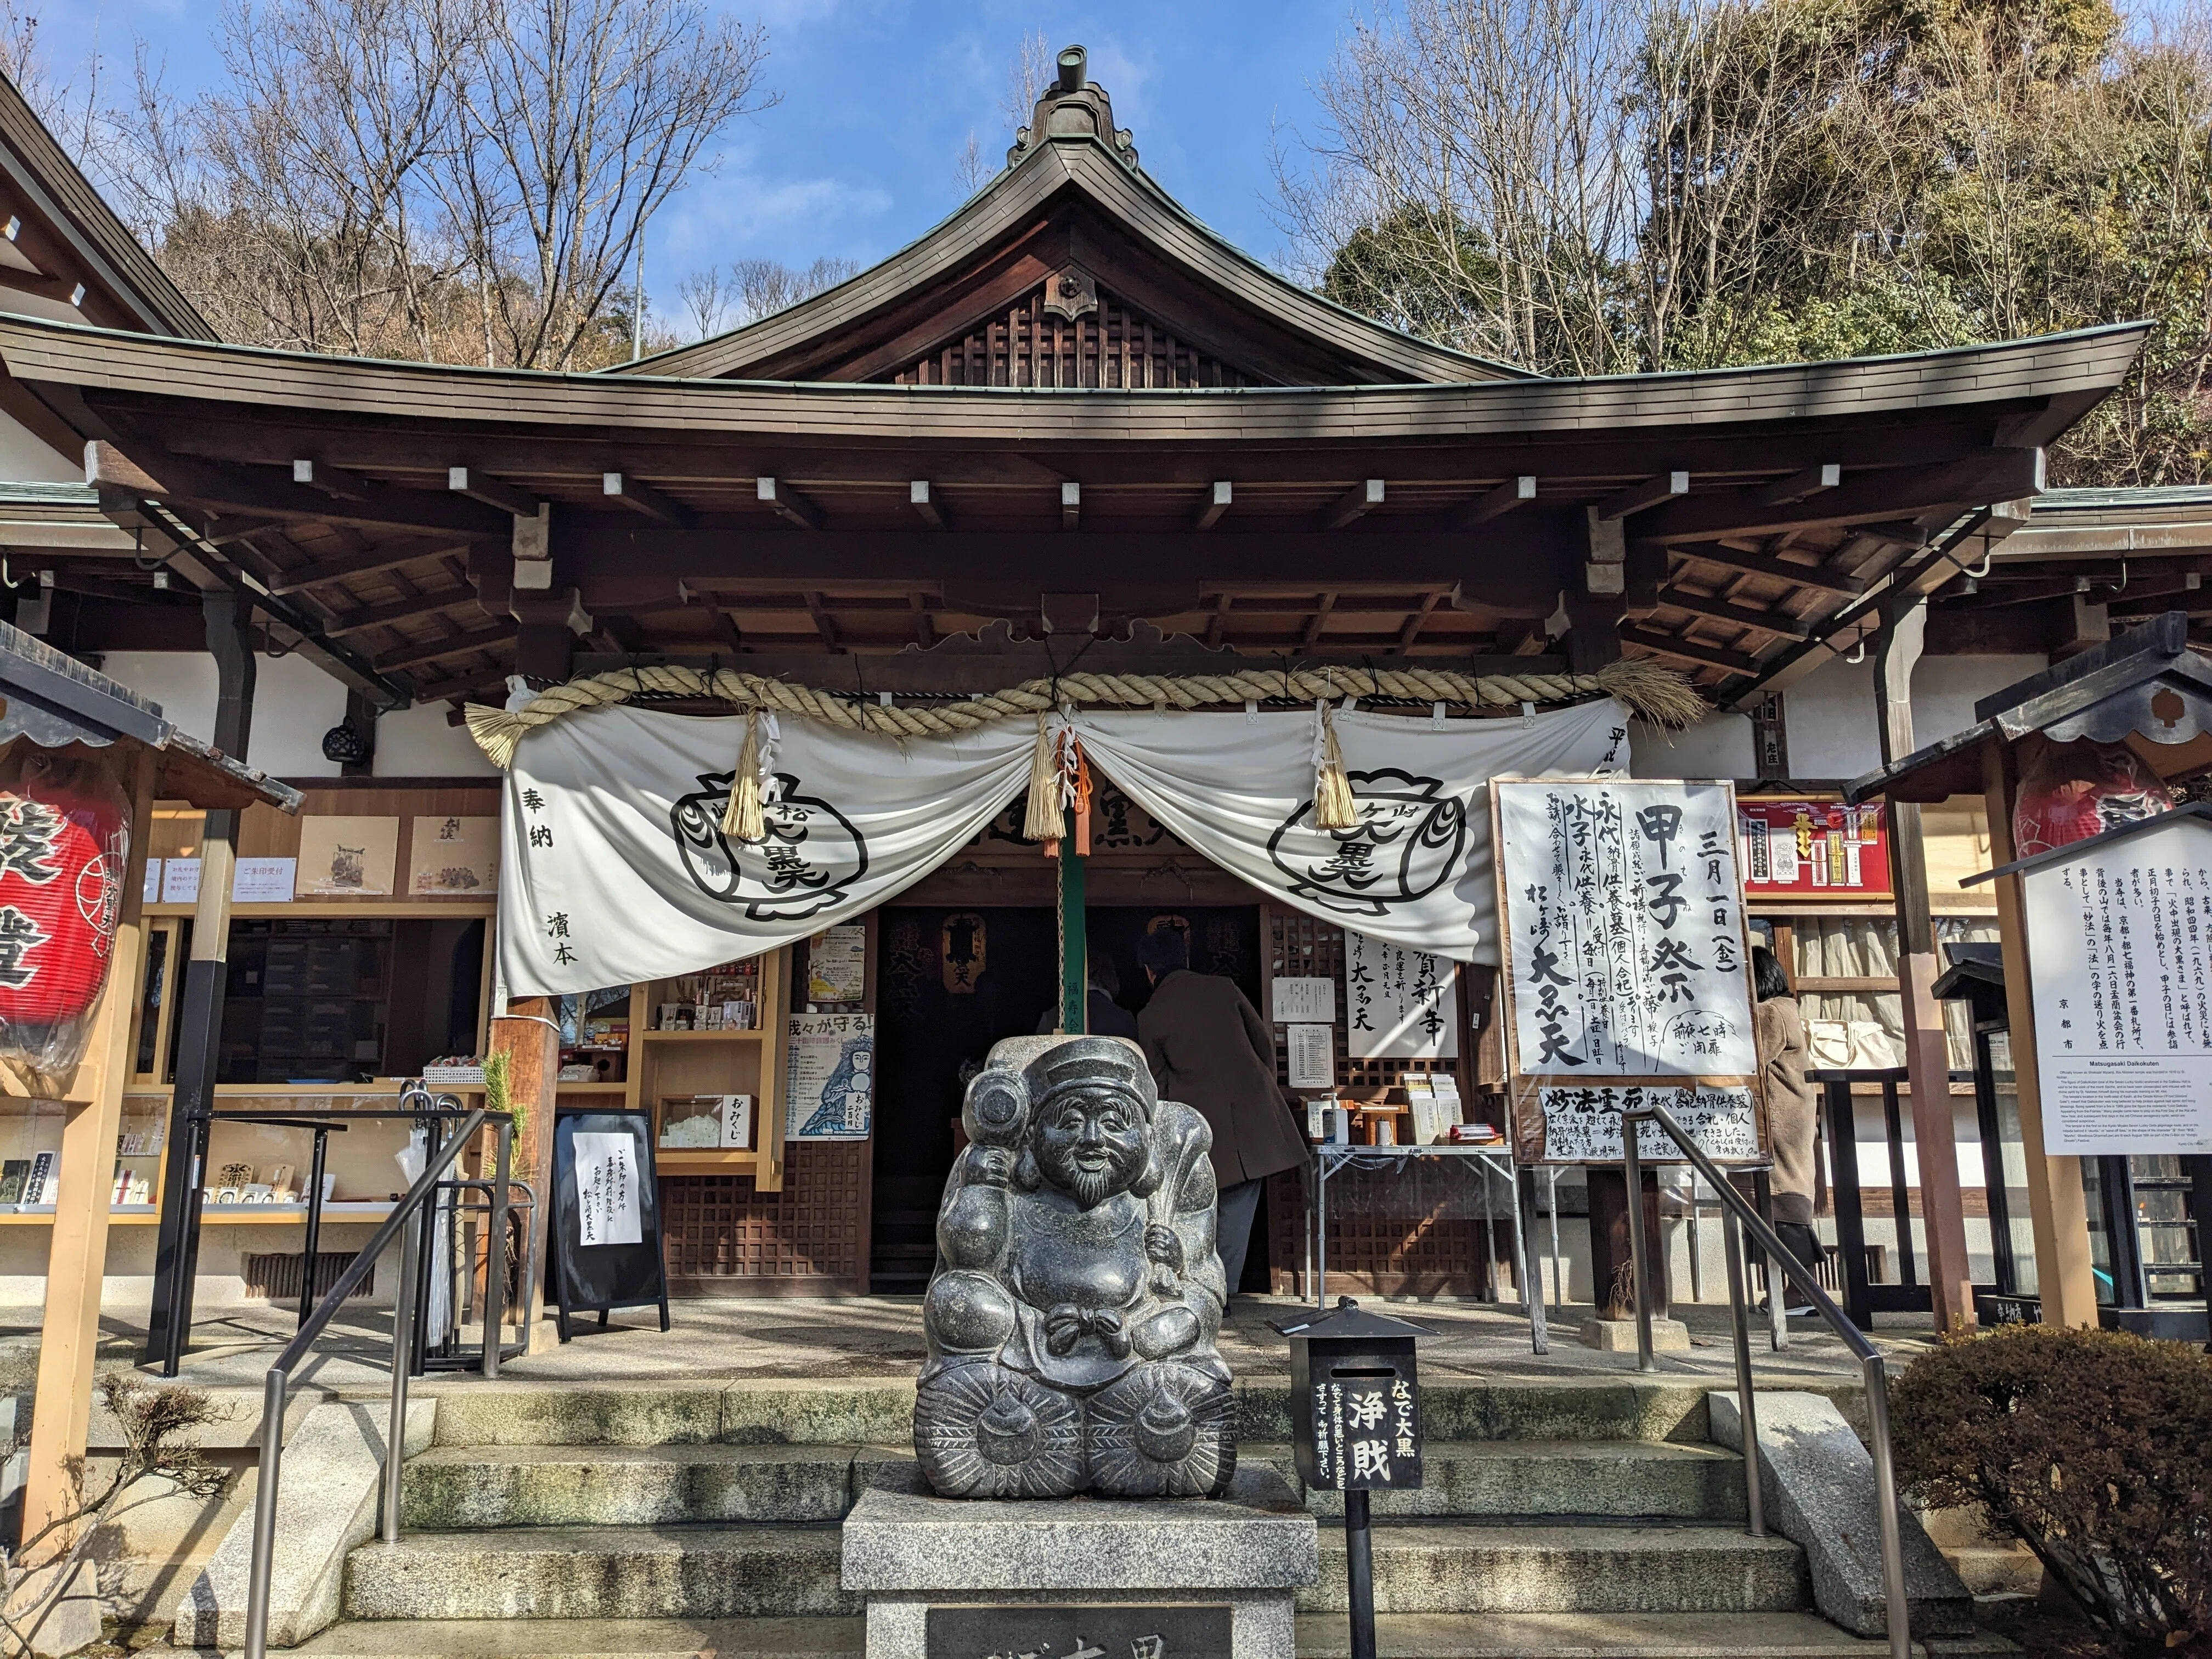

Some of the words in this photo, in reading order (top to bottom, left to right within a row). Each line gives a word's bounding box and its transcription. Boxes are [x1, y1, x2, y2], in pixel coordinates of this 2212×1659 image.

[521, 787, 554, 849] 奉納
[244, 867, 284, 876] ご朱印受付
[2062, 868, 2073, 890] ずる。
[2130, 868, 2144, 908] 者が多い。
[1635, 804, 1705, 1003] 甲子祭
[1066, 982, 1080, 1032] 福寿会
[2059, 999, 2073, 1049] 京都市
[1672, 1021, 1726, 1040] 前夜七時
[730, 1098, 743, 1140] おみくじ
[855, 1093, 865, 1128] おみくじ
[617, 1148, 627, 1211] ご朱印の方は
[1316, 1383, 1328, 1415] さすって
[1392, 1379, 1415, 1458] なで大黒
[1331, 1383, 1346, 1489] なでて身体の悪いところなどを
